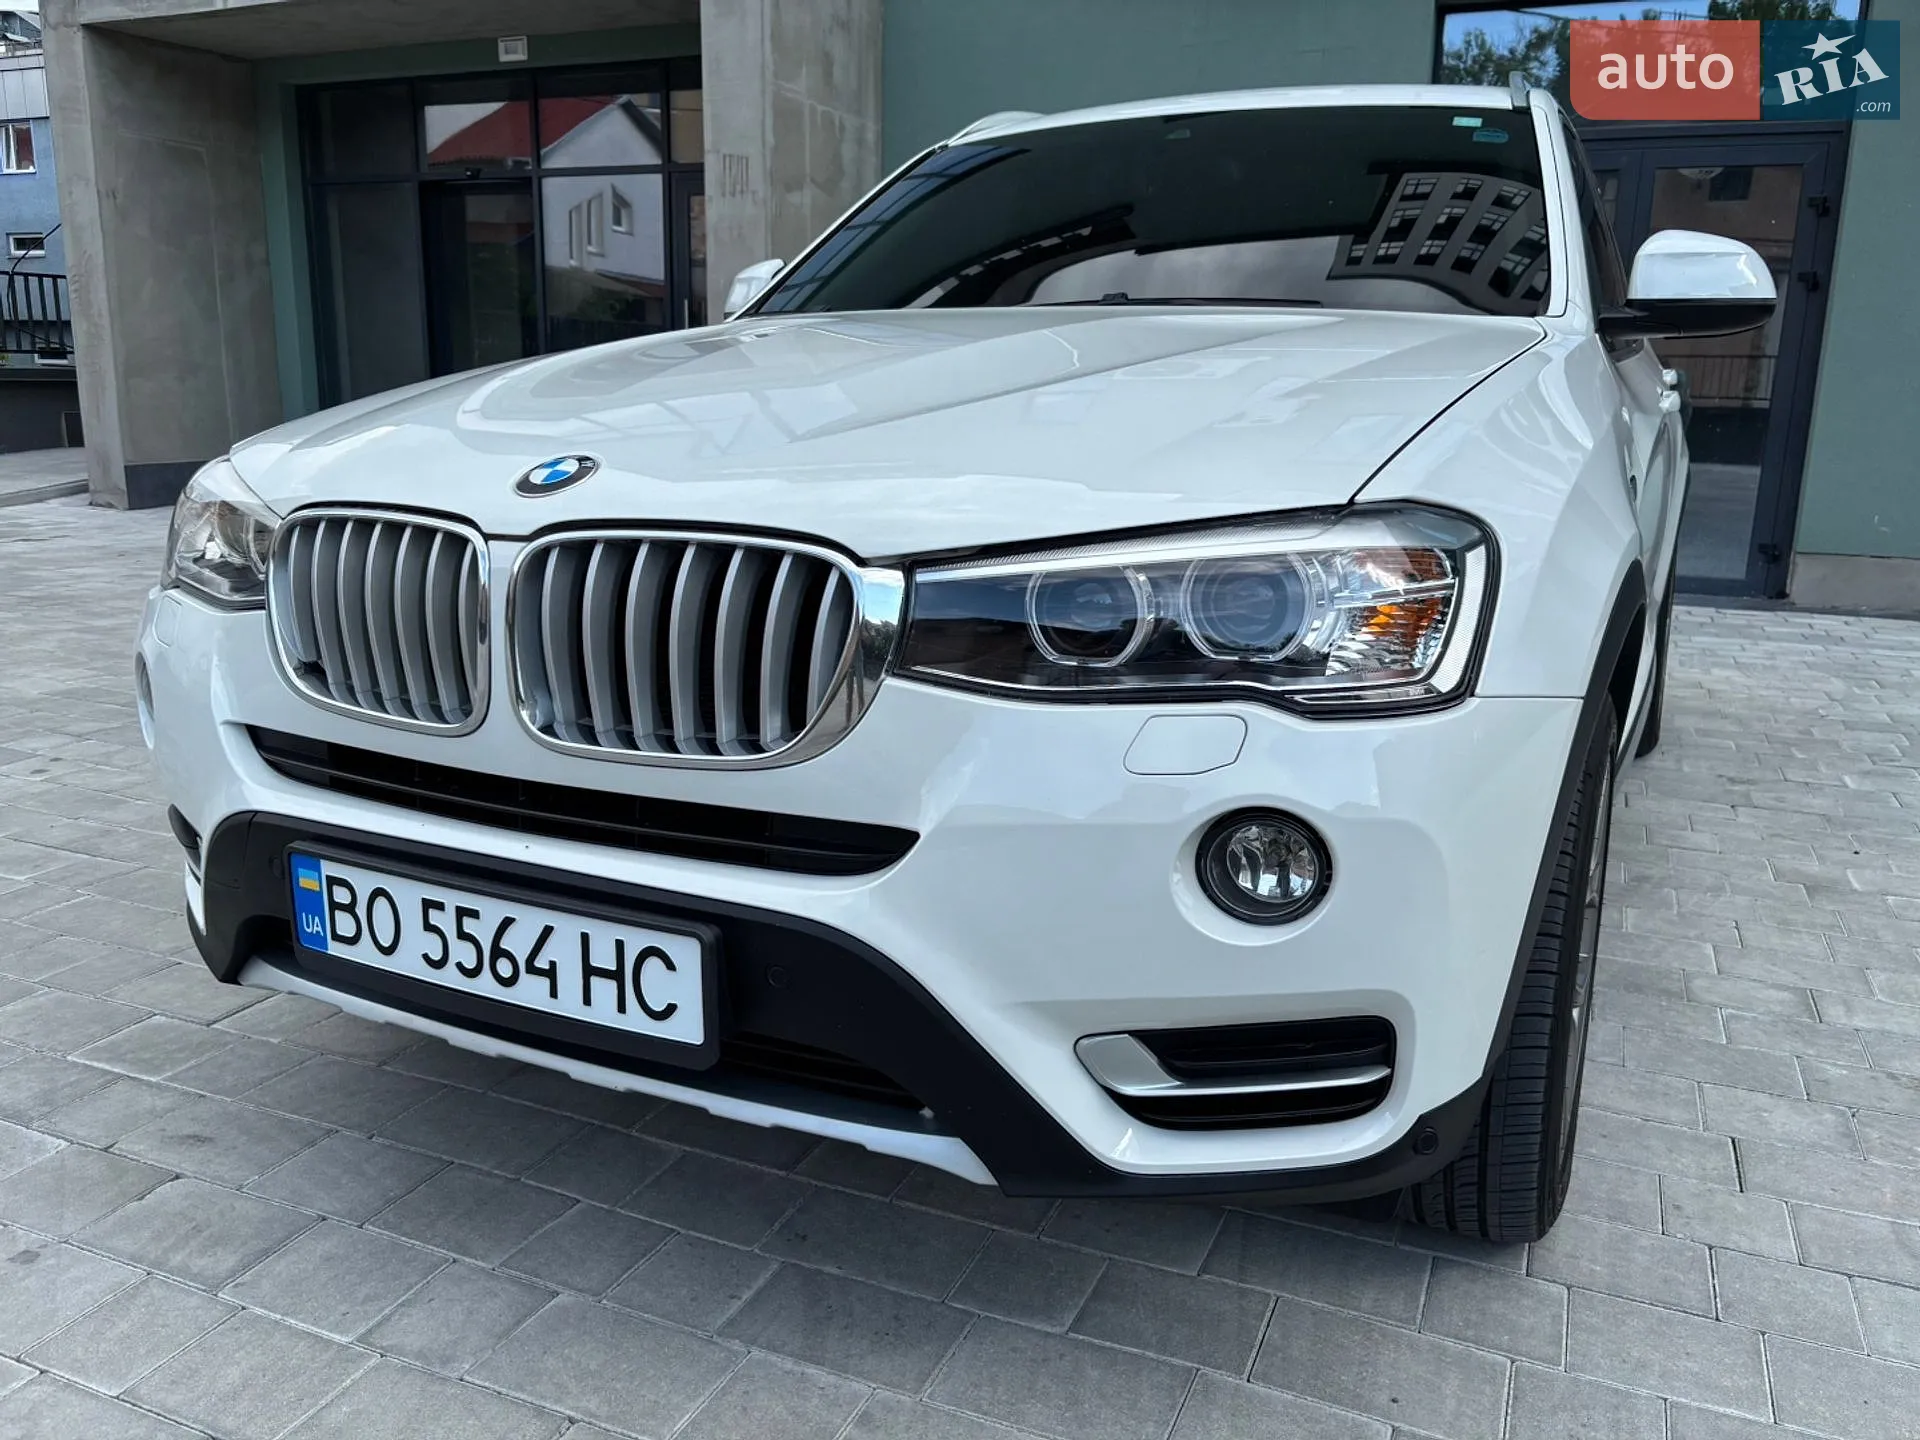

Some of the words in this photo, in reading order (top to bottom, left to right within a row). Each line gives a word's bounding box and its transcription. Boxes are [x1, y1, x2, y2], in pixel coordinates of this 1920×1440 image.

[302, 912, 324, 937] UA
[325, 874, 401, 956] BO
[421, 897, 558, 1000] 5564
[580, 931, 679, 1022] HC
